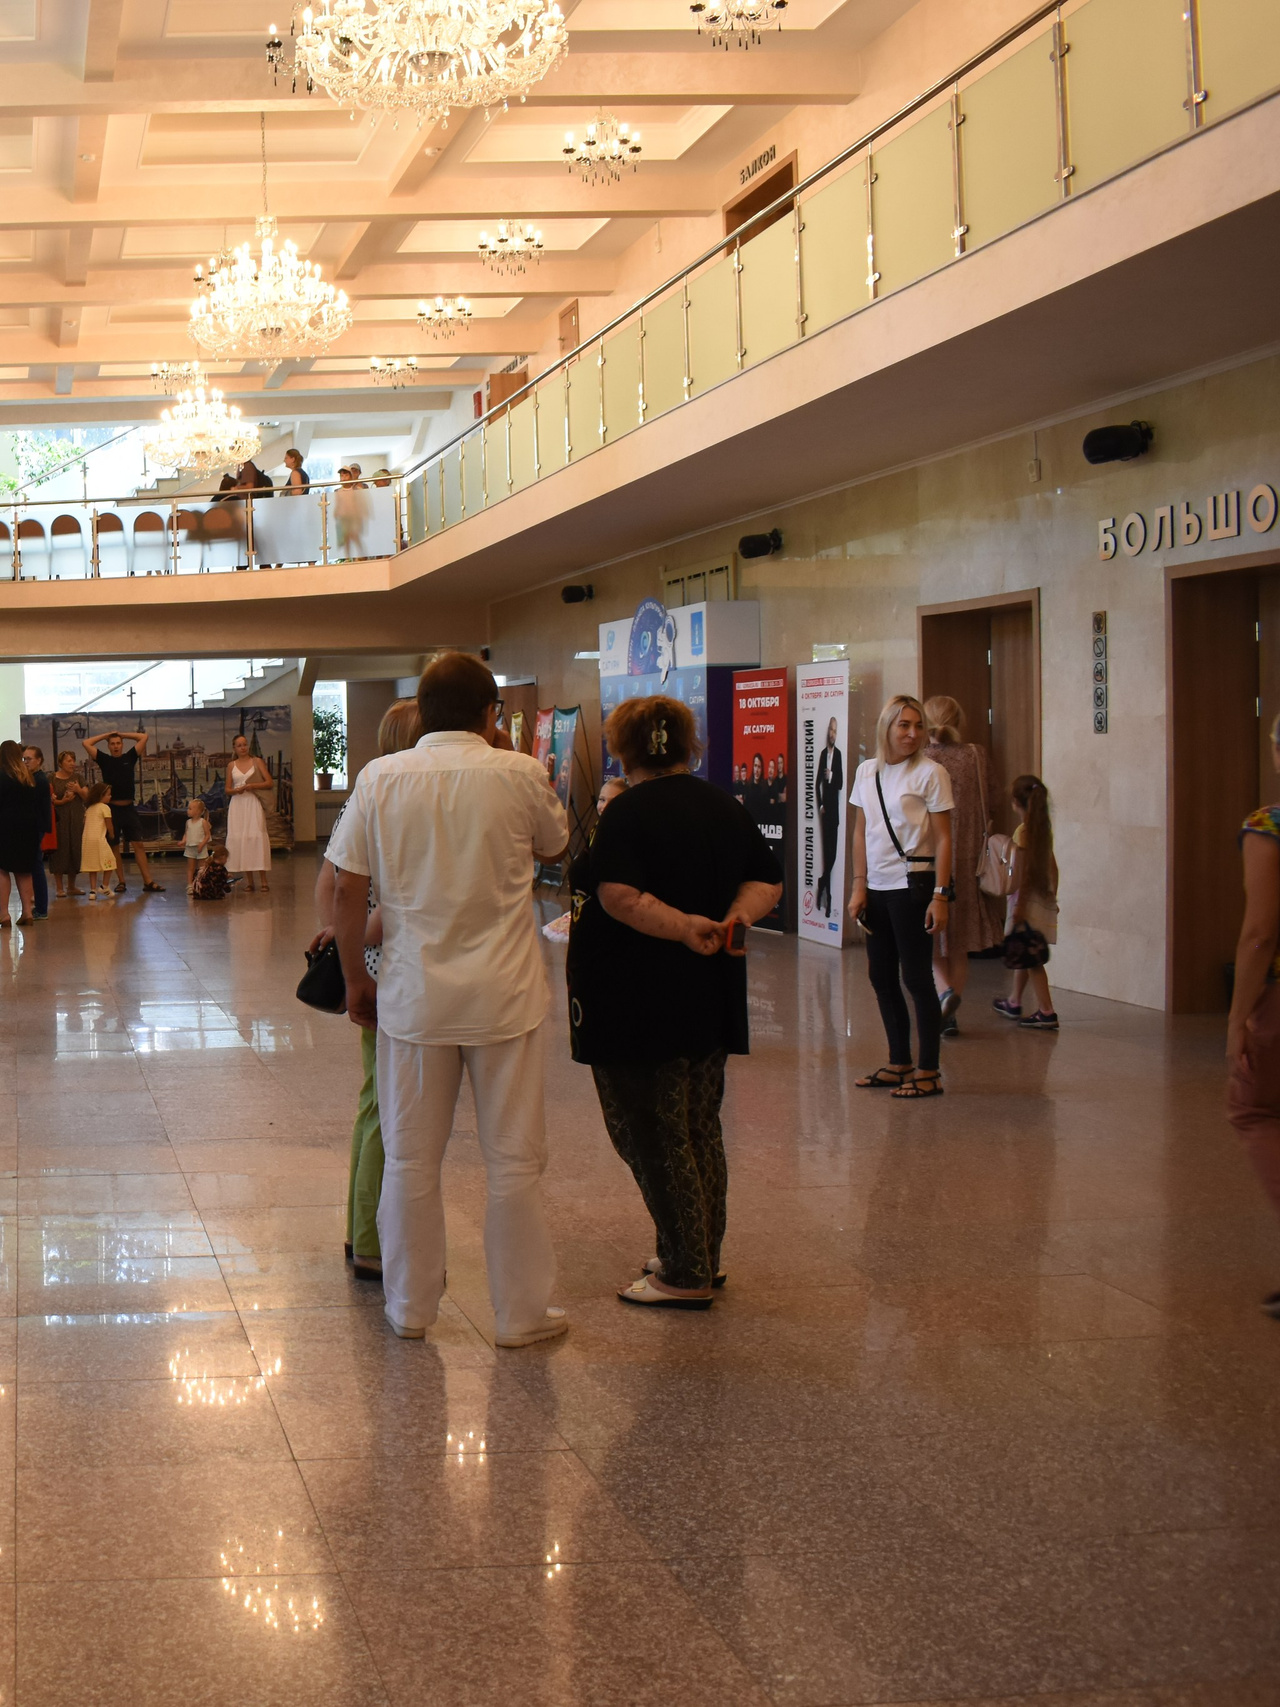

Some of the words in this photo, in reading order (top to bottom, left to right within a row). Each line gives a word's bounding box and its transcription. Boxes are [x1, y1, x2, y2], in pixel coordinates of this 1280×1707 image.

[740, 144, 776, 185] БАЛКОН
[1098, 483, 1279, 561] БОЛЬШО
[739, 698, 747, 709] 18
[747, 696, 780, 708] ОКТЯБРЯ
[743, 725, 751, 735] ДК
[752, 724, 775, 734] САТУРН
[803, 720, 814, 819] СУМИШЕВСКИЙ
[805, 827, 814, 886] ЯРОСЛАВ
